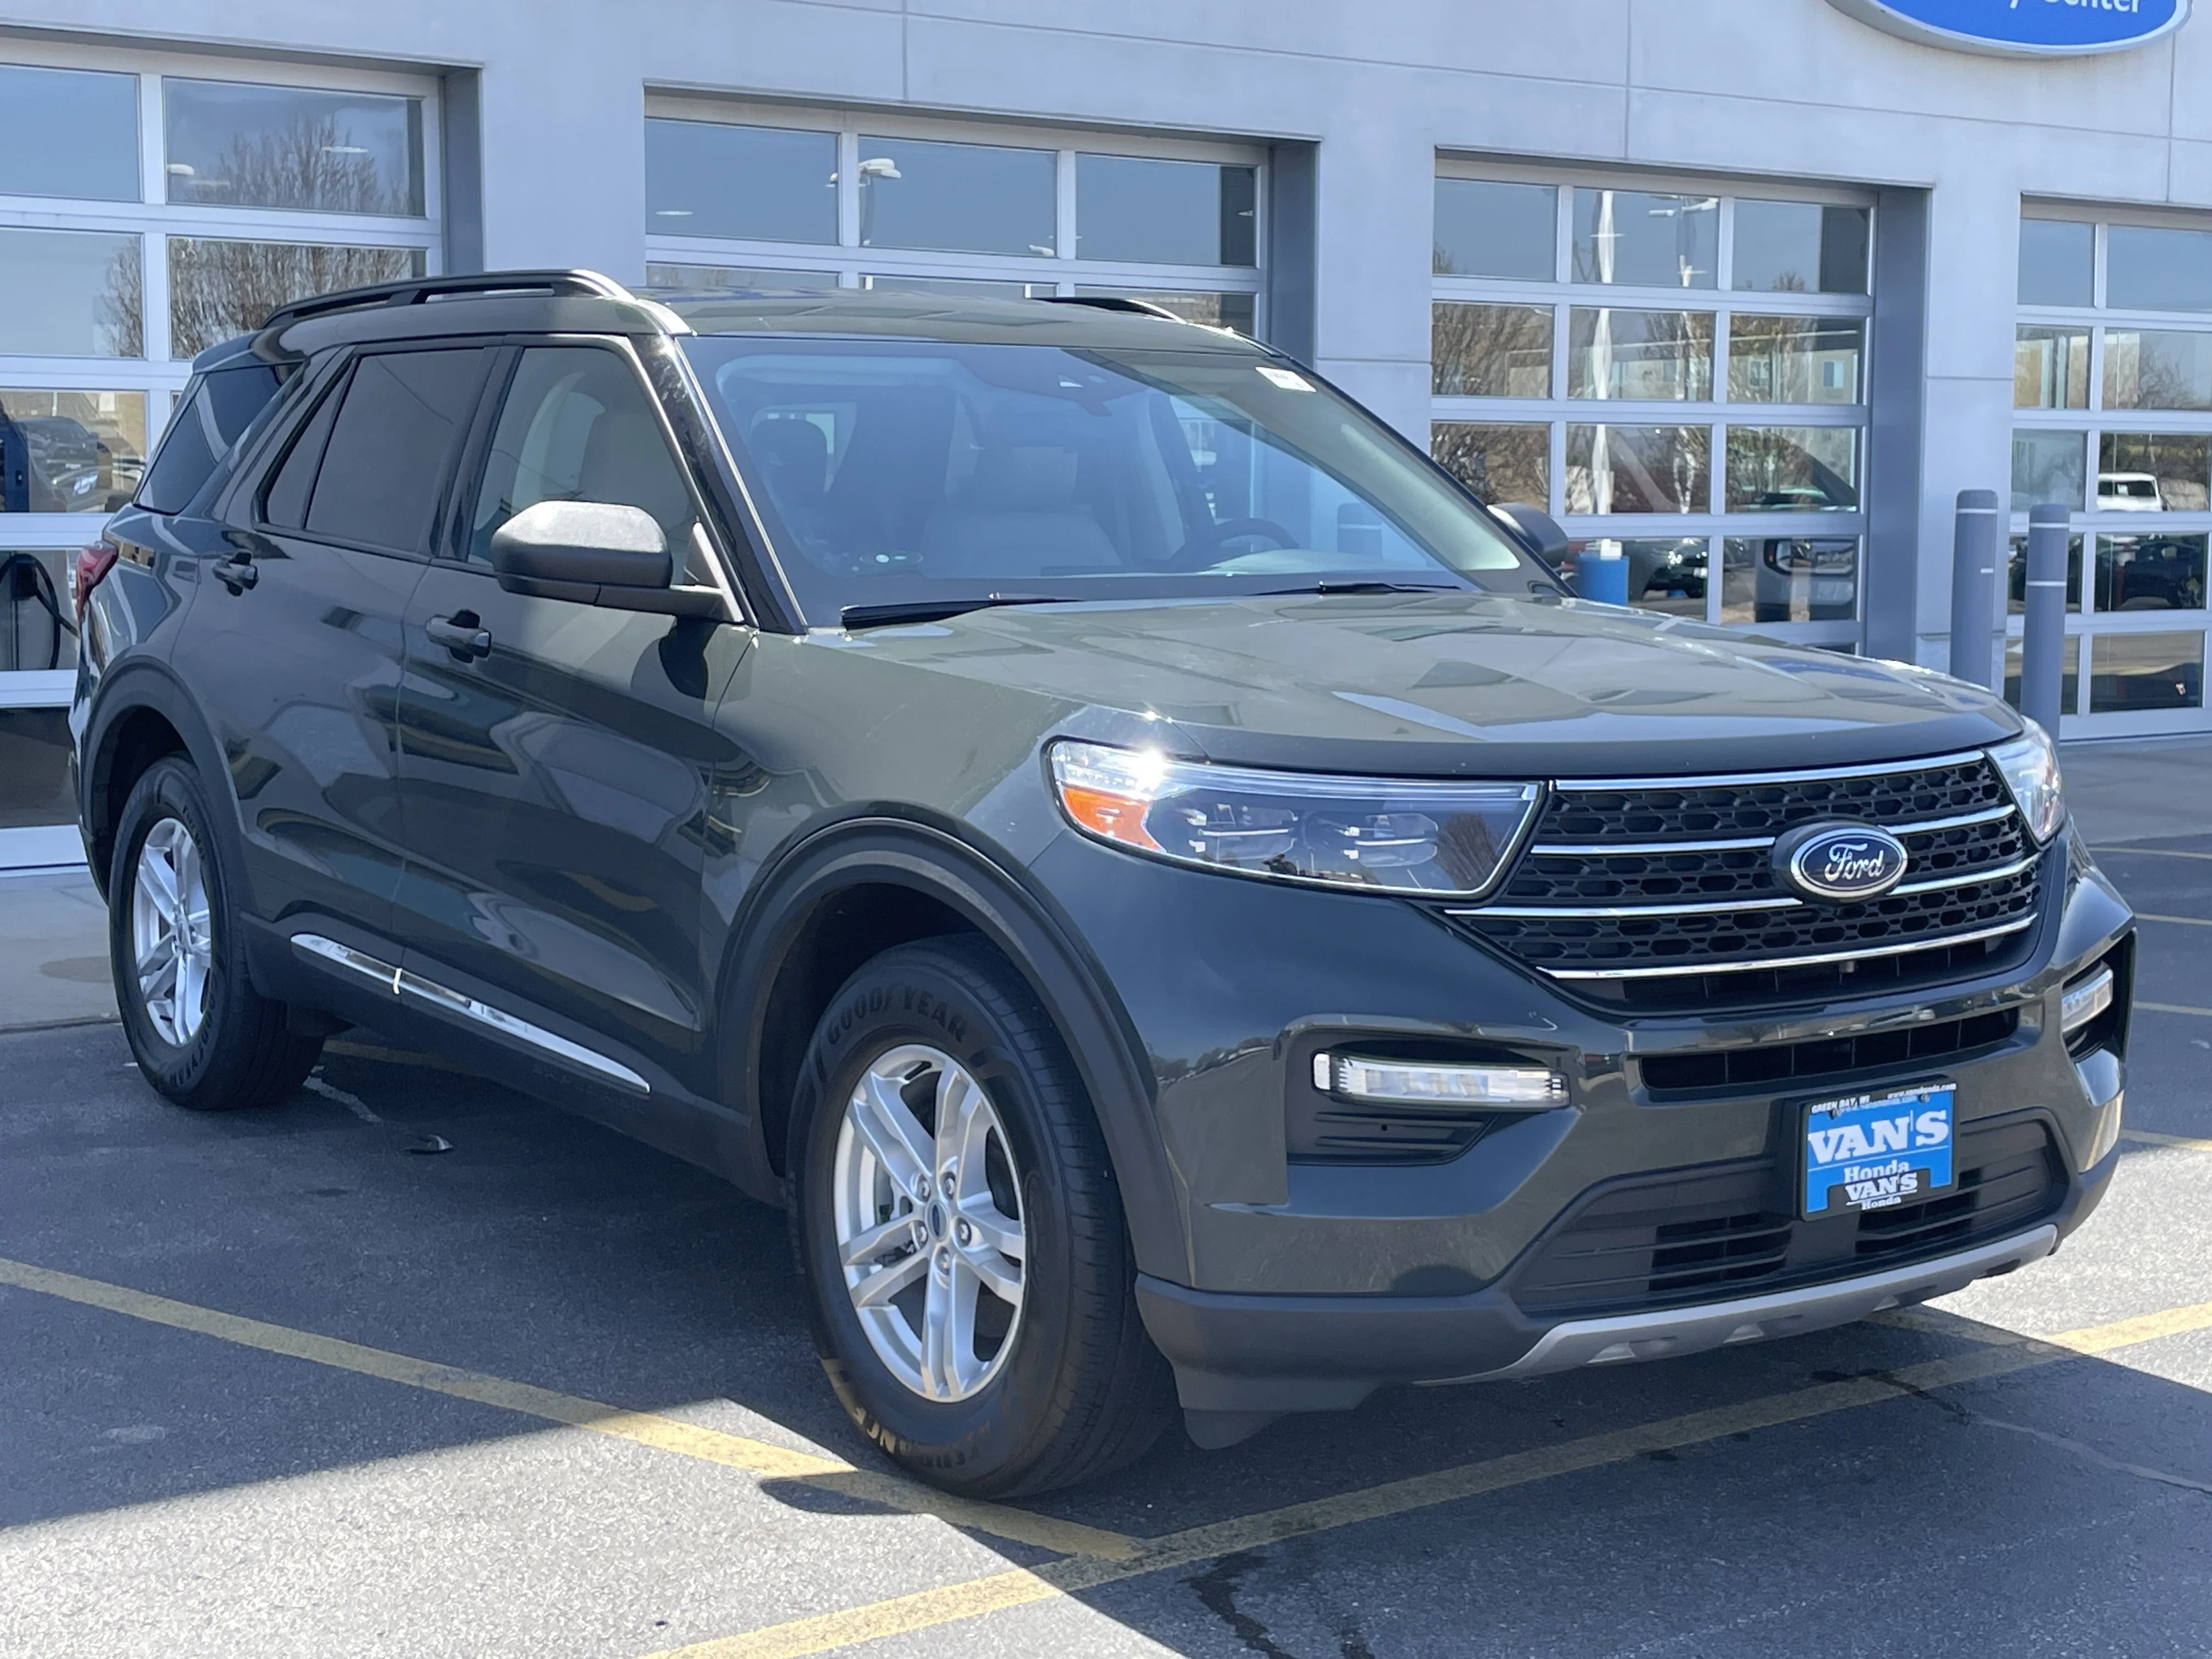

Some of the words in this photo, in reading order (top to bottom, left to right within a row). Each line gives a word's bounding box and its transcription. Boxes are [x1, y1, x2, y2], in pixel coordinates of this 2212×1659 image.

[1824, 843, 1885, 882] Ford
[1807, 1109, 1949, 1164] VAN'S
[1843, 1159, 1910, 1183] Honda
[1844, 1172, 1918, 1201] VAN'S
[1861, 1195, 1901, 1210] Honda
